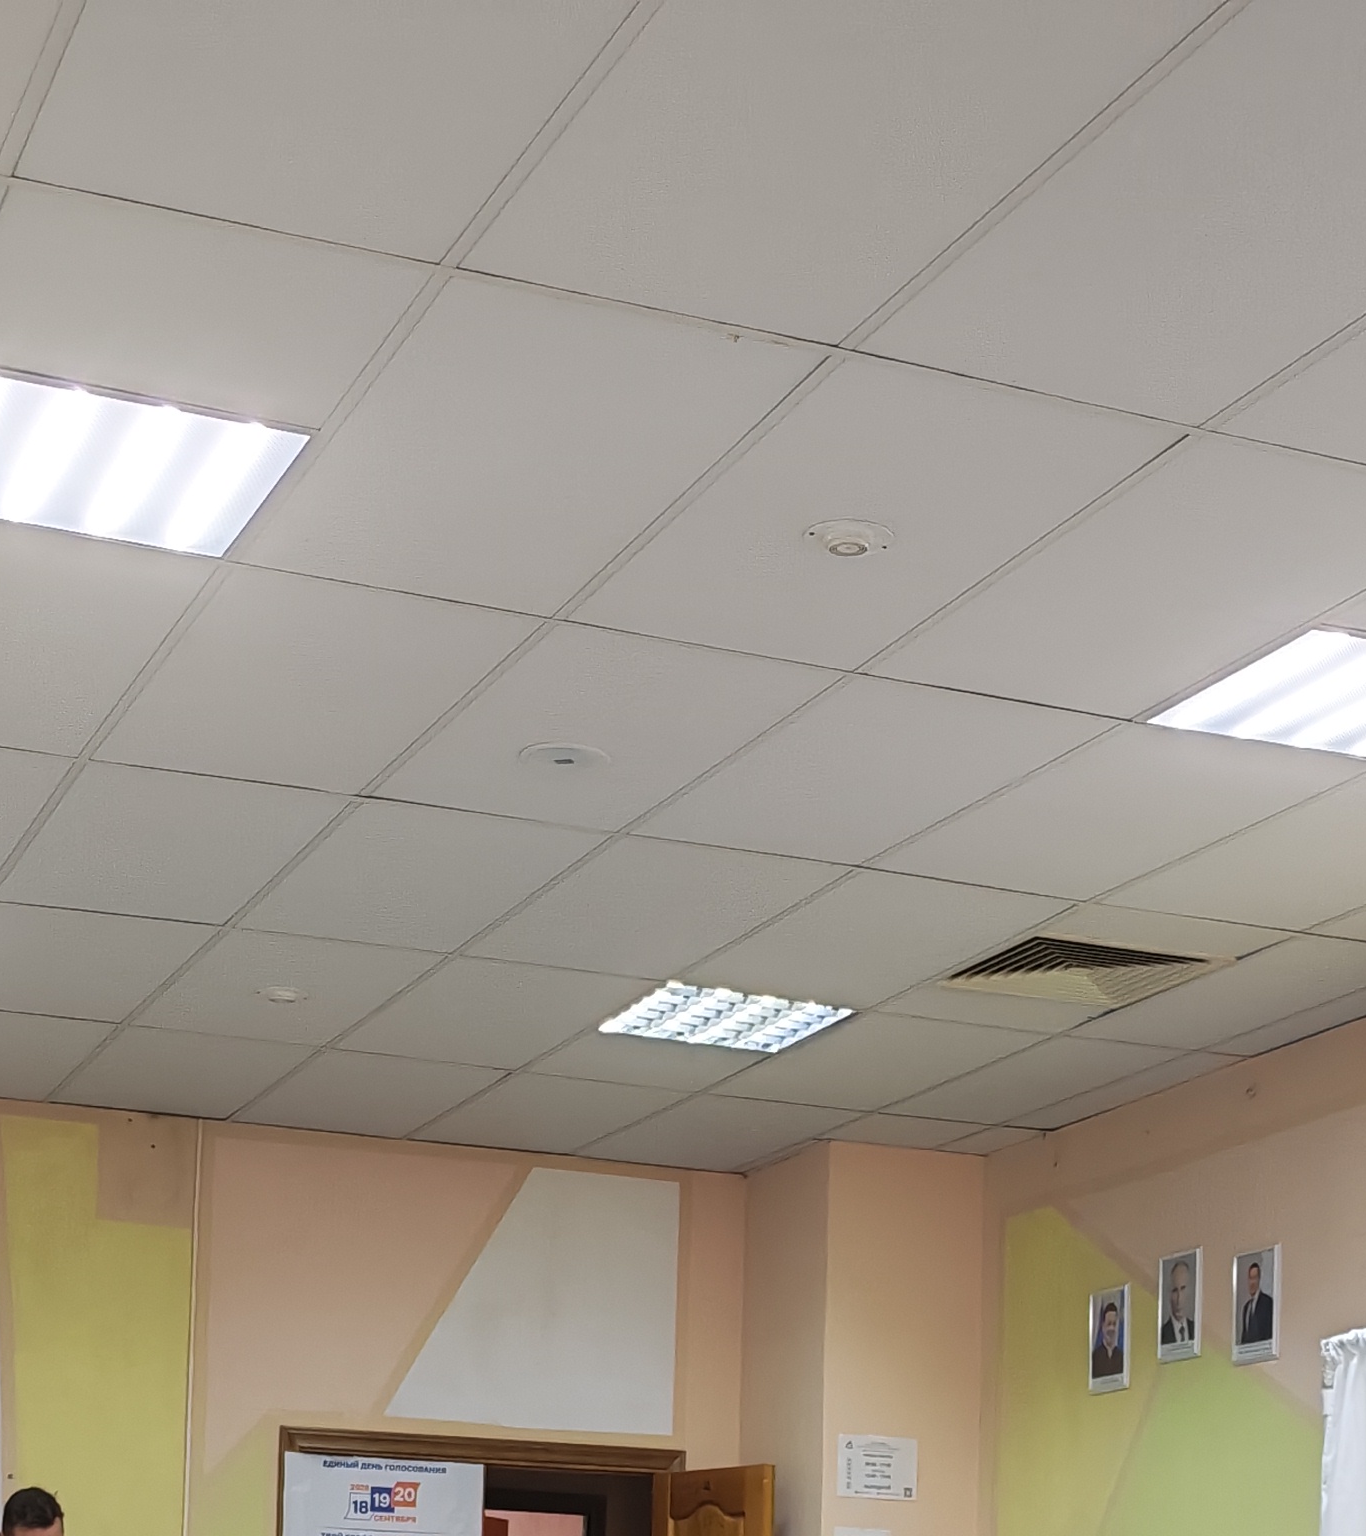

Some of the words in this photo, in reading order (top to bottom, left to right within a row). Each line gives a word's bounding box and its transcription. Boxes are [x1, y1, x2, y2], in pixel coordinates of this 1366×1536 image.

[322, 1459, 359, 1469] ЕДИНЫЙ
[360, 1462, 383, 1471] ДЕНЬ
[384, 1464, 447, 1474] ГОЛОСОВАНИЯ
[352, 1500, 369, 1514] 18
[373, 1492, 391, 1508] 19
[394, 1487, 415, 1502] 20
[373, 1514, 417, 1523] СЕНТЯБРЯ
